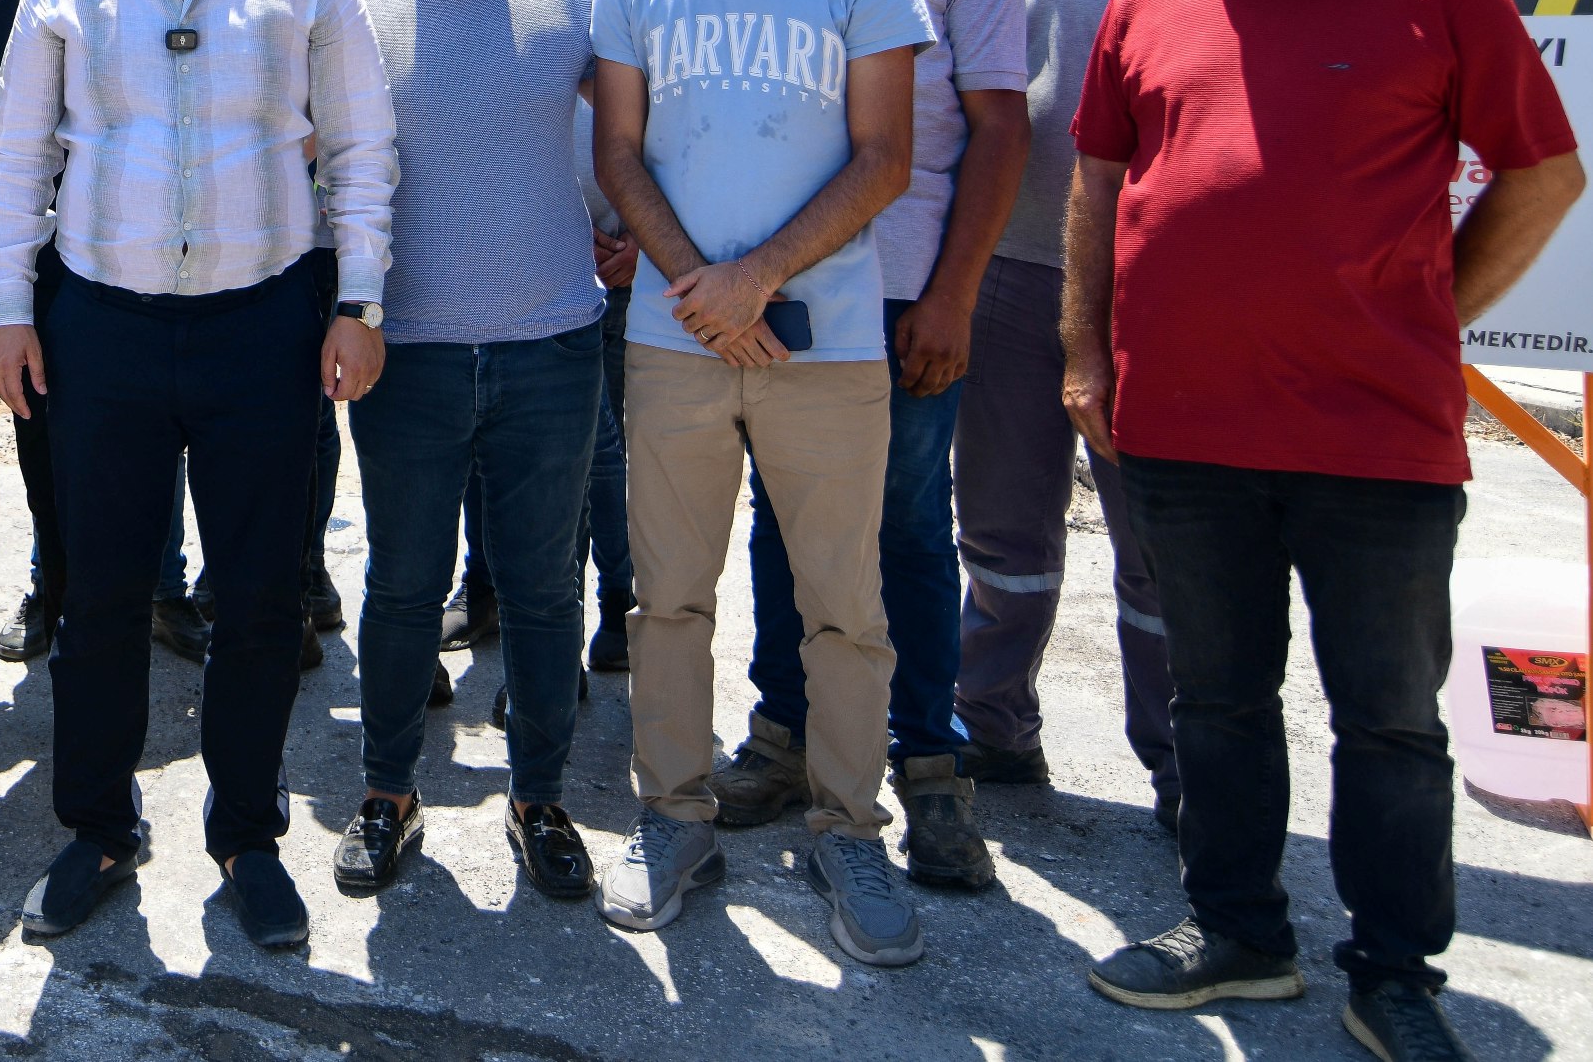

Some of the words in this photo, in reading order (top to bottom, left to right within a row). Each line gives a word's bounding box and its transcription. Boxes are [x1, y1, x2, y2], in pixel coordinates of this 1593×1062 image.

[646, 12, 847, 101] HARVARD
[653, 79, 828, 111] UNVERSITY
[1534, 657, 1560, 668] SMX
